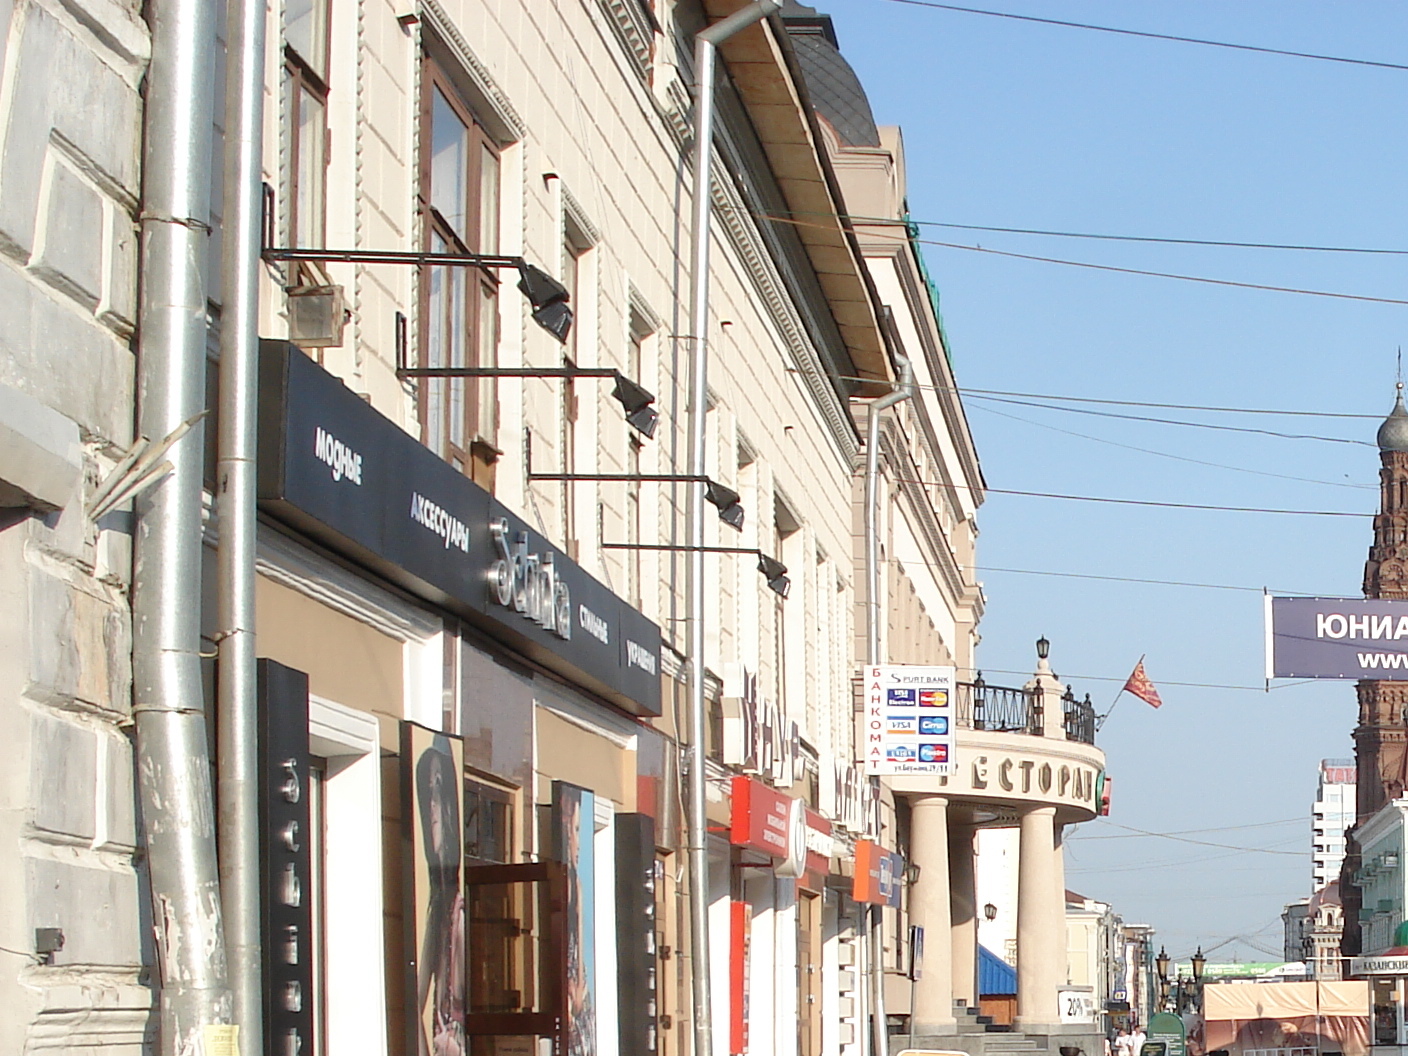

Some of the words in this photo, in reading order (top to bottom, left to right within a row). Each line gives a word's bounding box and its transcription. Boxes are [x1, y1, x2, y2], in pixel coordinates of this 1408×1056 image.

[410, 491, 469, 553] АКСЕССУАРЫ
[870, 668, 882, 769] БАНКОМАТ
[939, 756, 1093, 803] ЕСТОРАН
